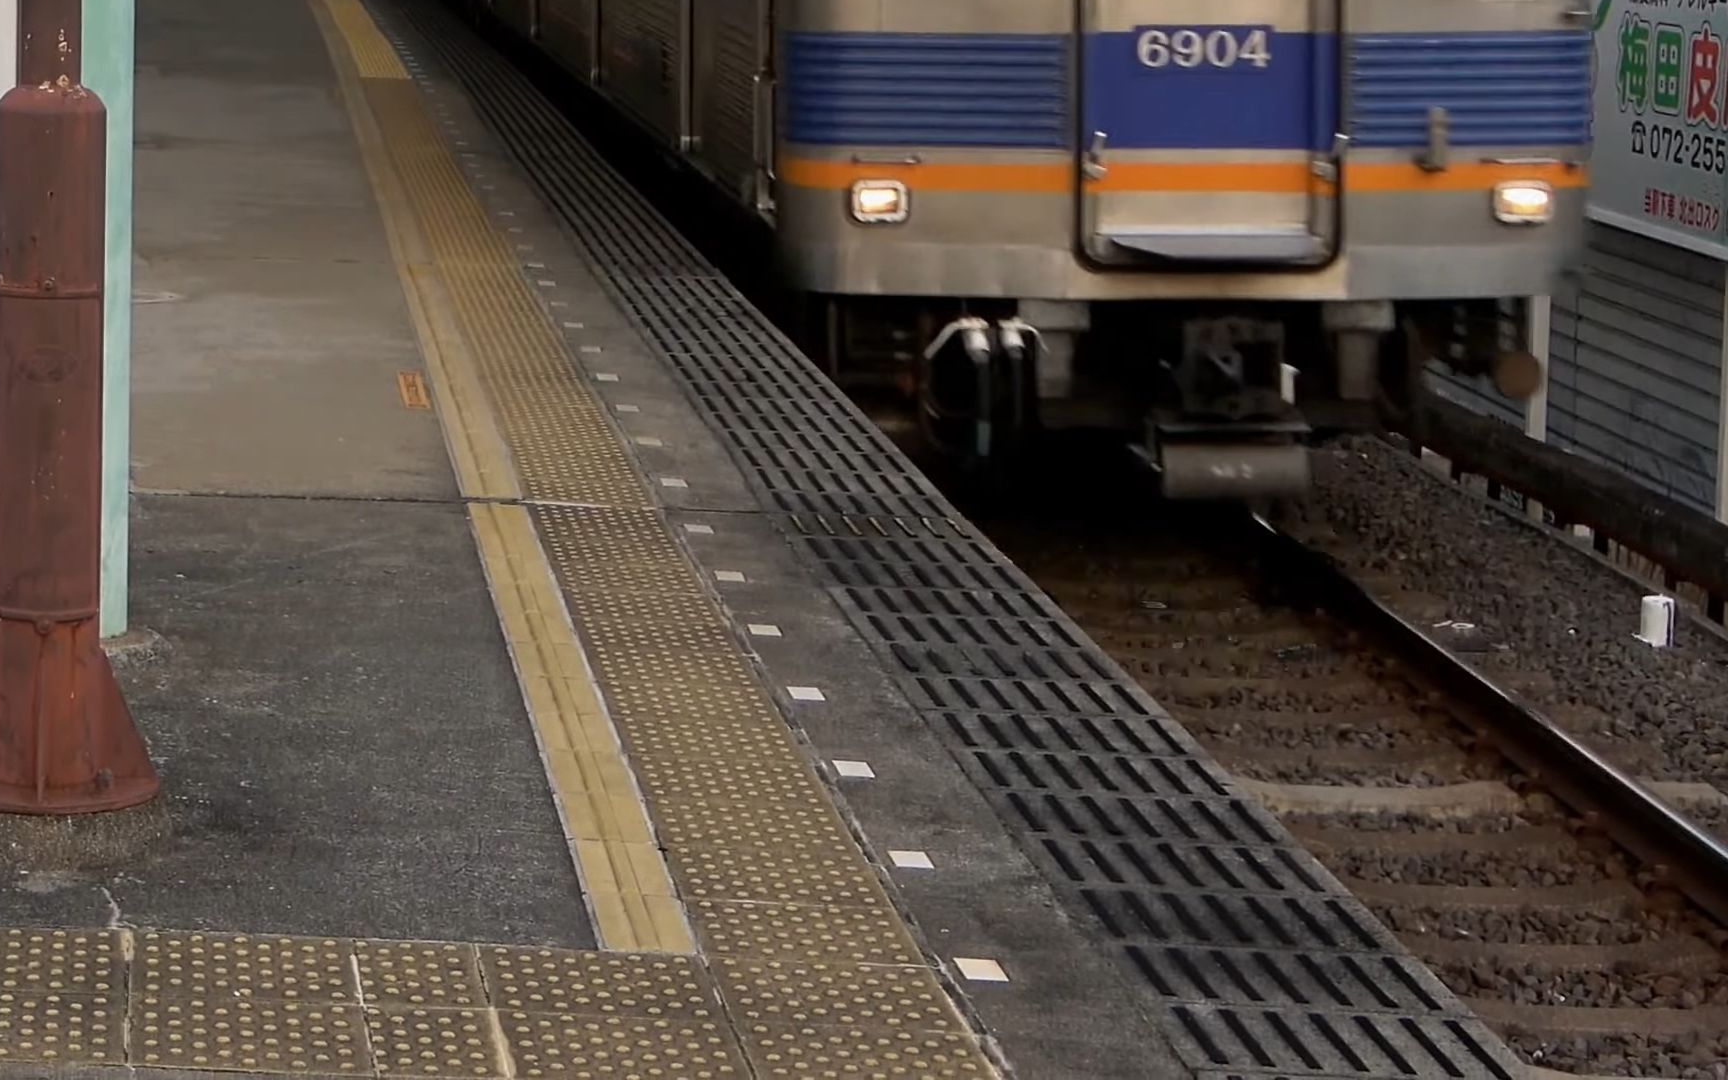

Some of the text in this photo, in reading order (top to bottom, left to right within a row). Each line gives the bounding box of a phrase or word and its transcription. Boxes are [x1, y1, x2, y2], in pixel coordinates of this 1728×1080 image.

[1136, 30, 1272, 68] 6904
[1616, 11, 1728, 131] 梅田皮
